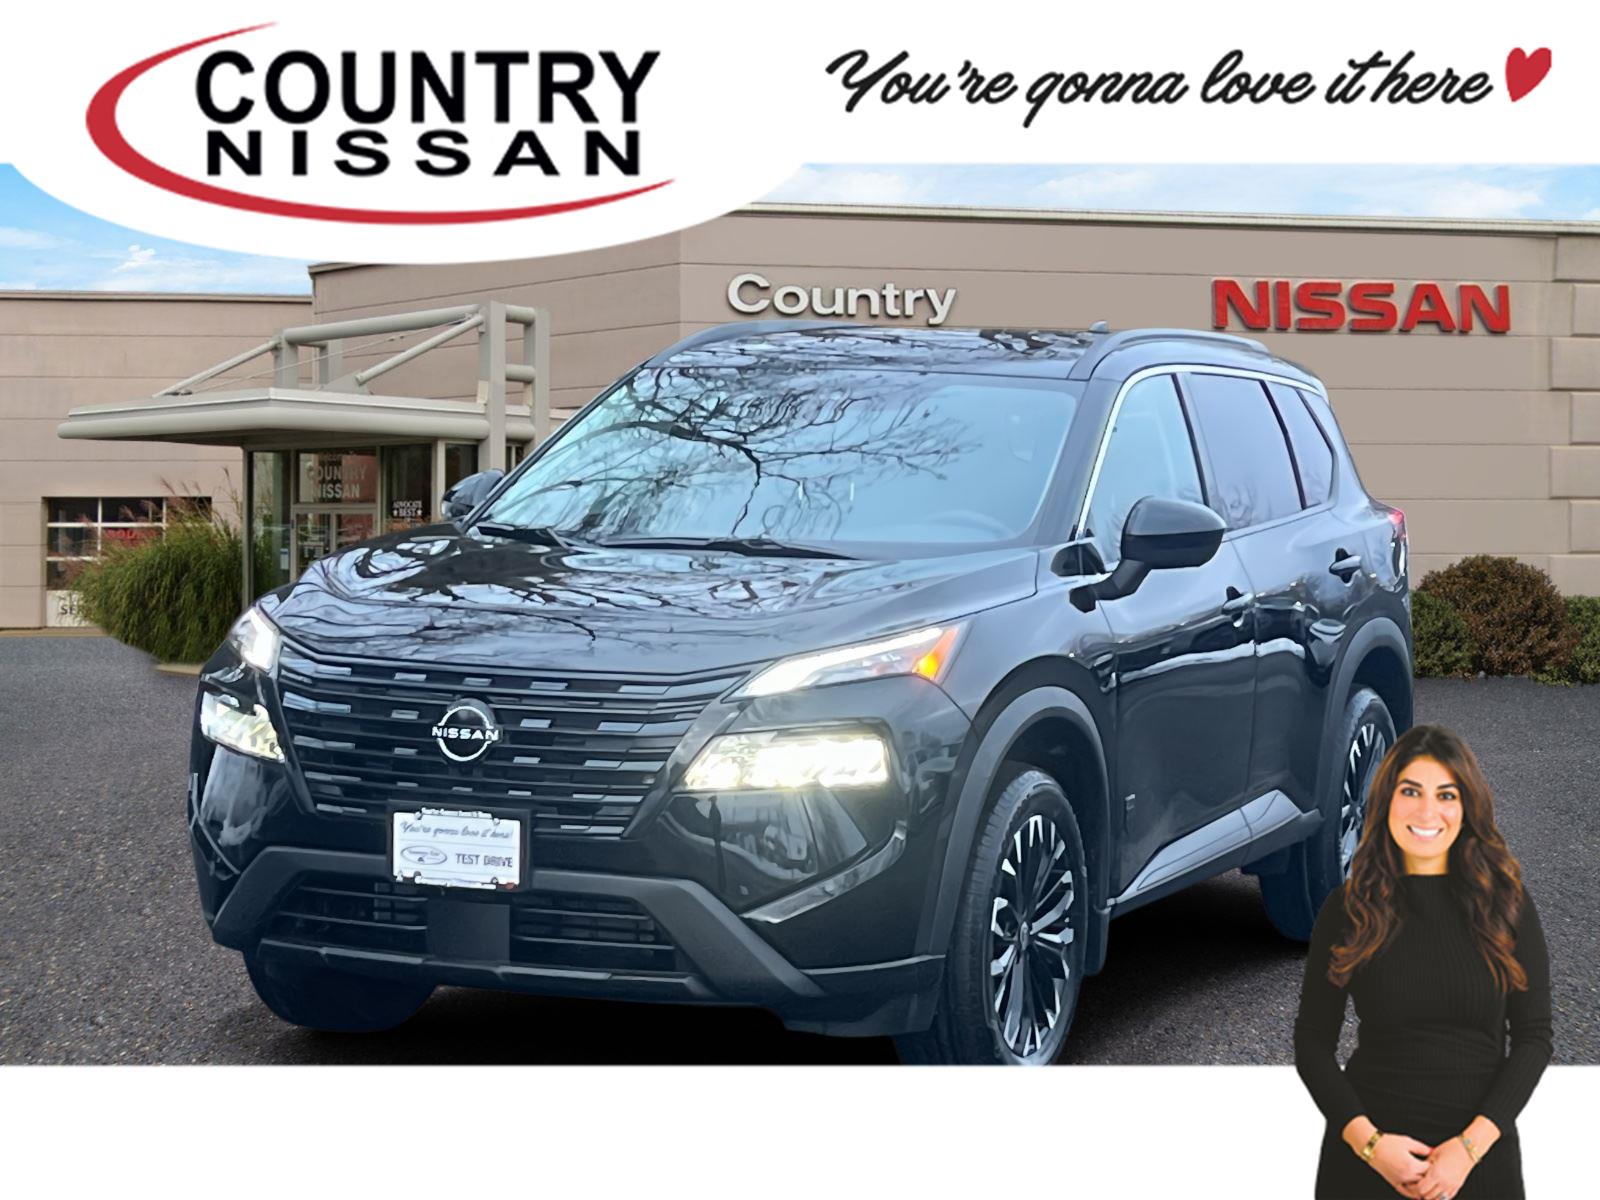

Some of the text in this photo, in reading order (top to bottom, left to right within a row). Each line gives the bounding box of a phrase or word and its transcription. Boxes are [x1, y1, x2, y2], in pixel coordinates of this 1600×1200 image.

[727, 273, 957, 326] Country
[1213, 276, 1511, 334] NISSAN
[307, 464, 367, 480] COUNTRY
[313, 483, 360, 499] NISSAN
[431, 726, 499, 741] NISSAN
[456, 852, 480, 866] TEST
[483, 854, 513, 868] DRIVE
